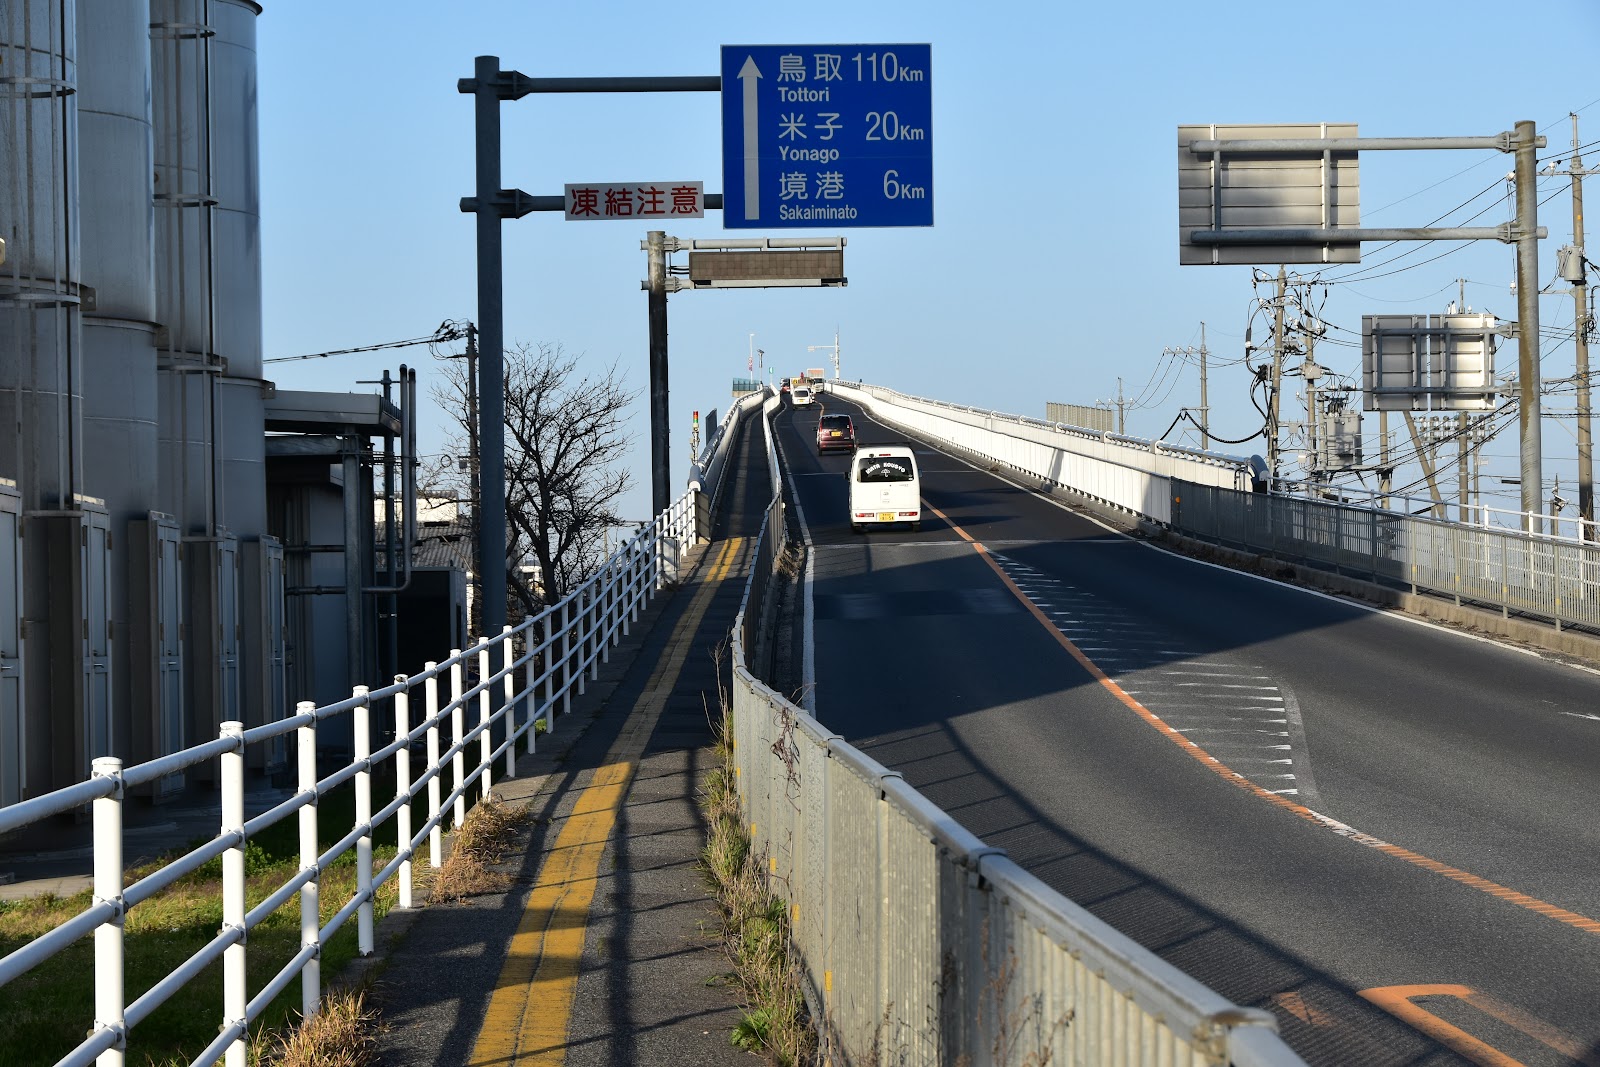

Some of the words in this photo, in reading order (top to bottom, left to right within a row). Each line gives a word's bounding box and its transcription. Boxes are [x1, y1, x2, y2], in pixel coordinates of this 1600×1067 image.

[777, 53, 843, 83] 鳥取
[851, 52, 923, 82] 110Km
[777, 87, 830, 102] Tottori
[778, 112, 843, 141] 米子
[865, 111, 924, 141] 20Km
[778, 145, 840, 164] Yonago
[778, 171, 845, 200] 境港
[883, 169, 925, 200] 6Km
[570, 185, 699, 217] 凍結注意
[779, 204, 858, 220] Sakaiminato
